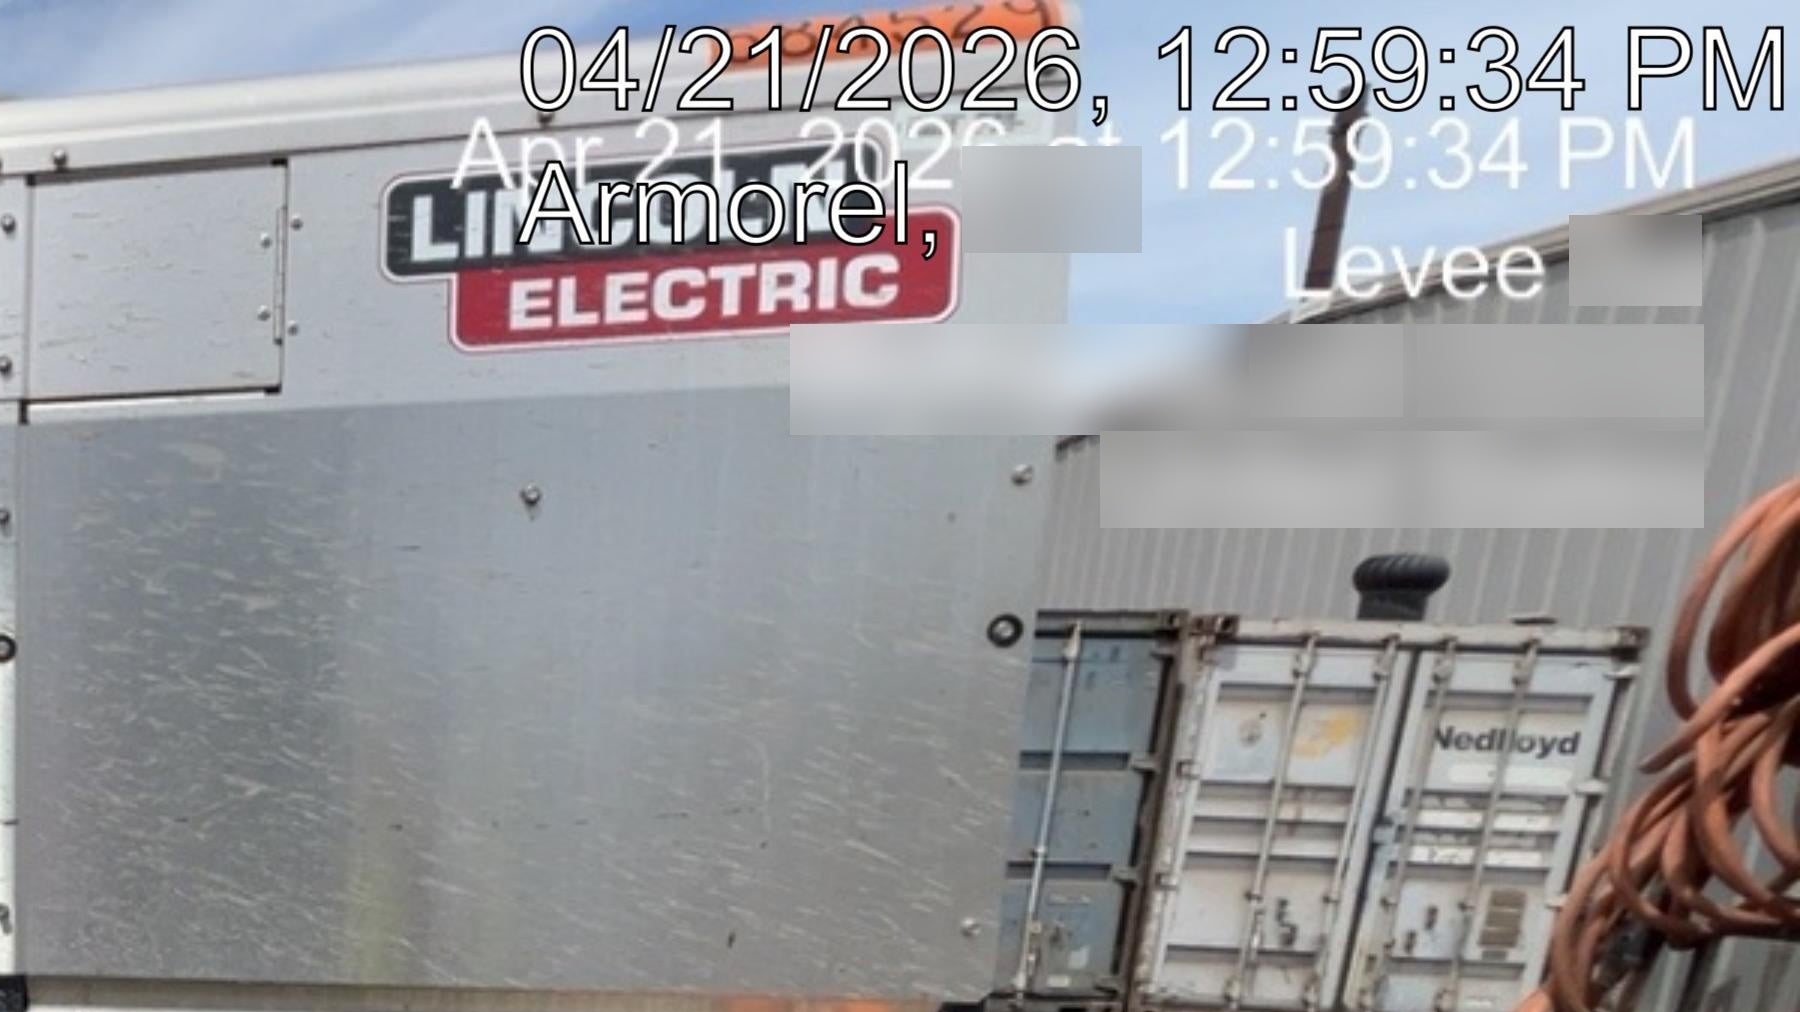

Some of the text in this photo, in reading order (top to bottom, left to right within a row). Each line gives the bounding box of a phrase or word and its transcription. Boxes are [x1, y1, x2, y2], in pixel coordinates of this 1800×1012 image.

[410, 158, 849, 263] LINCOLN
[508, 252, 899, 332] ELECTRIC
[1435, 724, 1582, 760] Nedlloyd
